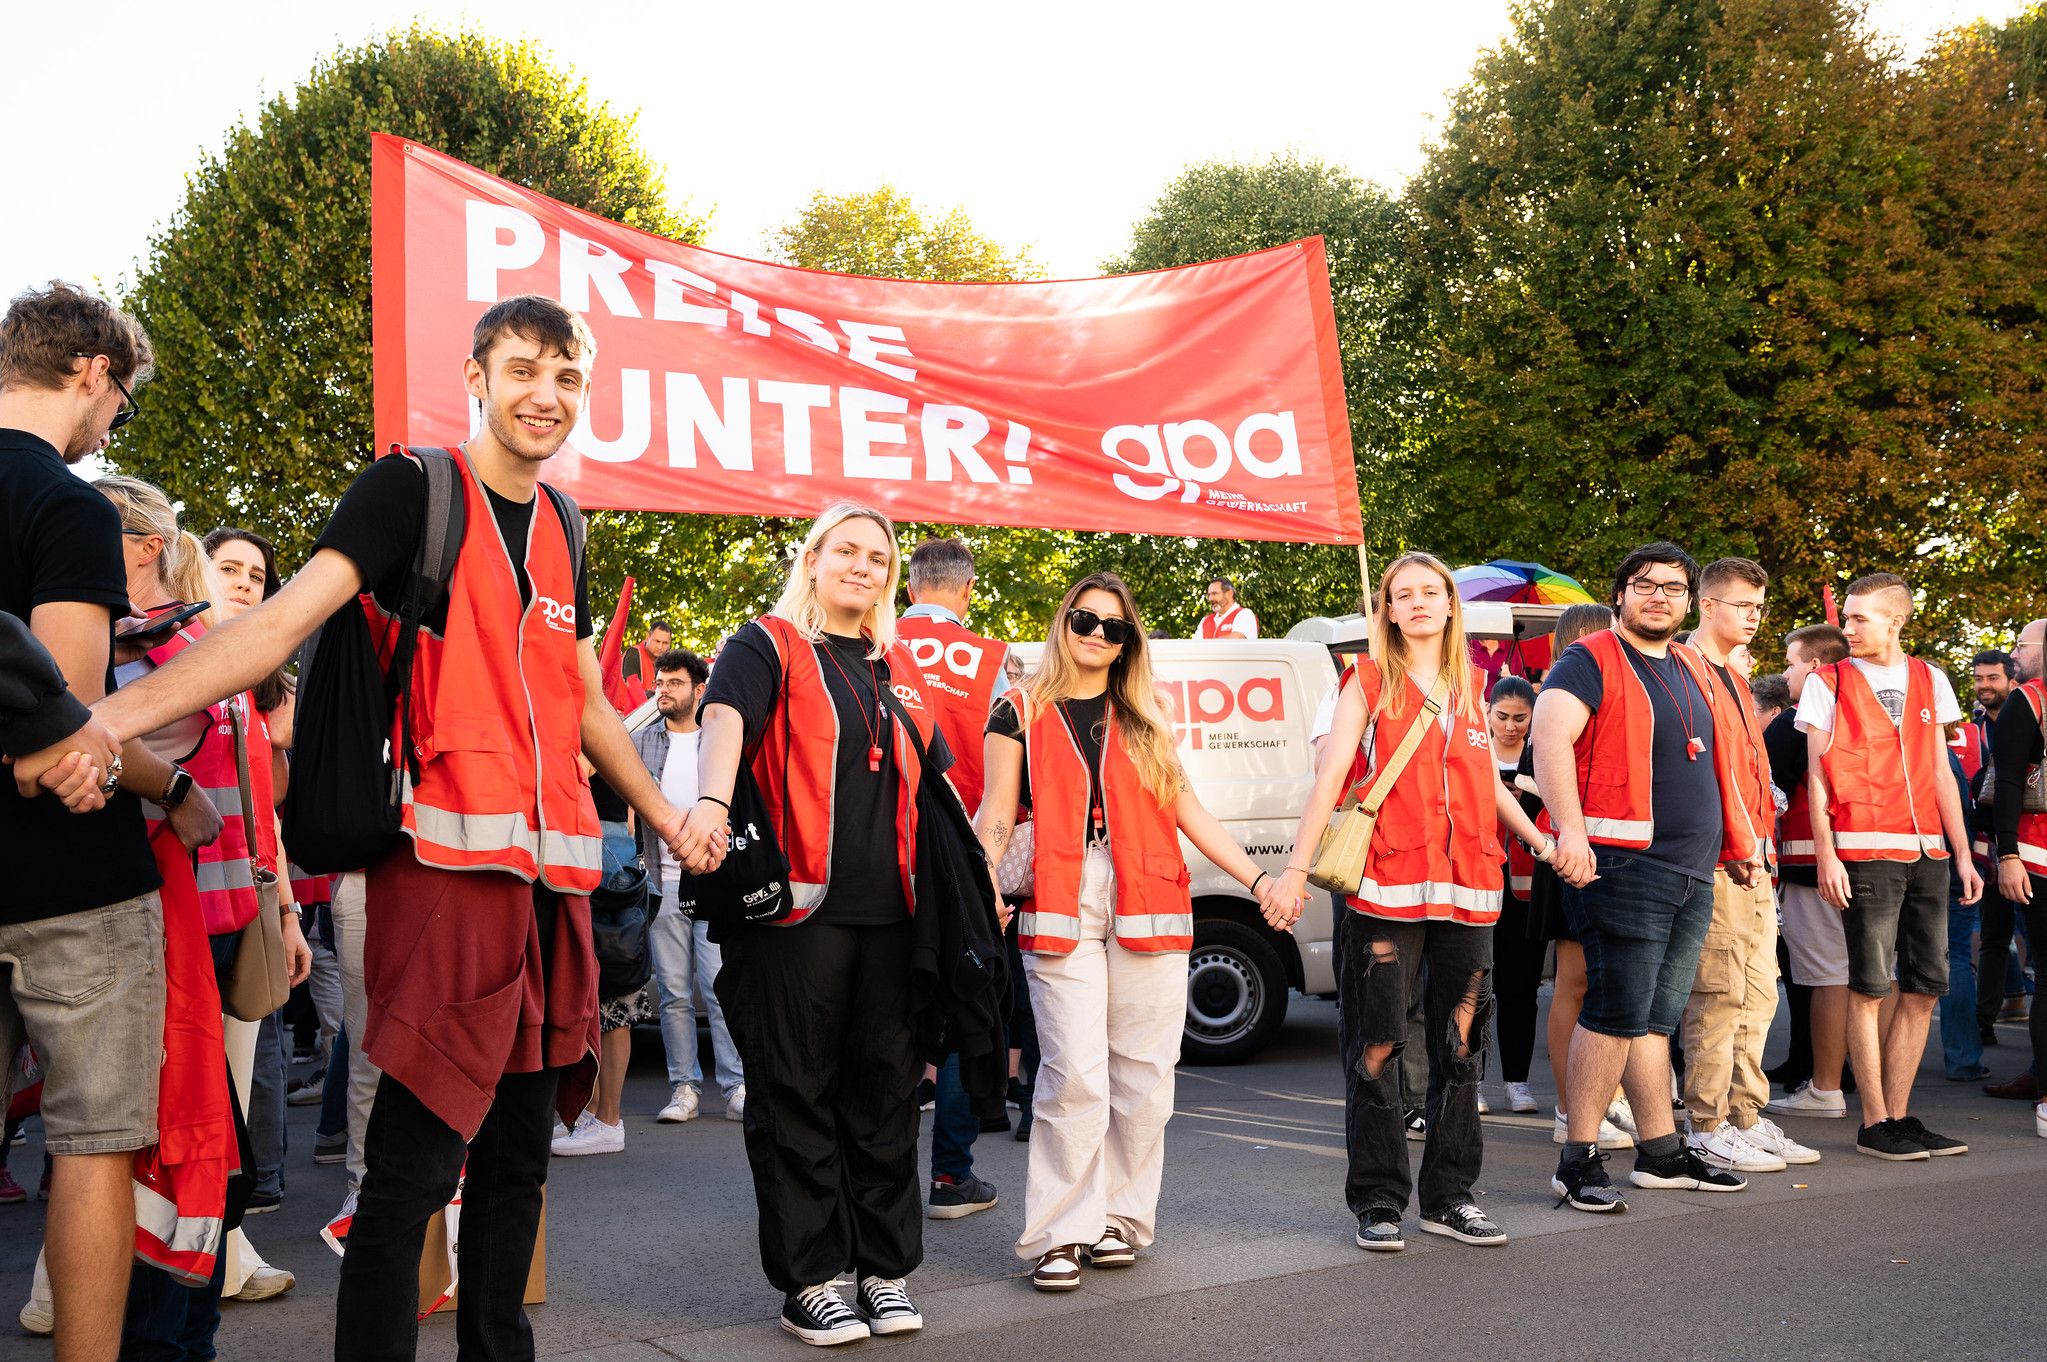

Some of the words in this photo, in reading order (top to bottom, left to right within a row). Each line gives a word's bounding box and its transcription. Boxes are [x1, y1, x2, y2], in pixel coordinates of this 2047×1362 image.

[465, 199, 918, 382] PREISE
[469, 368, 1033, 486] UNTER!
[1101, 410, 1304, 503] gpa
[899, 637, 984, 680] pa
[1208, 732, 1240, 741] MEINE
[1208, 740, 1288, 750] GEWERKSCHAFT
